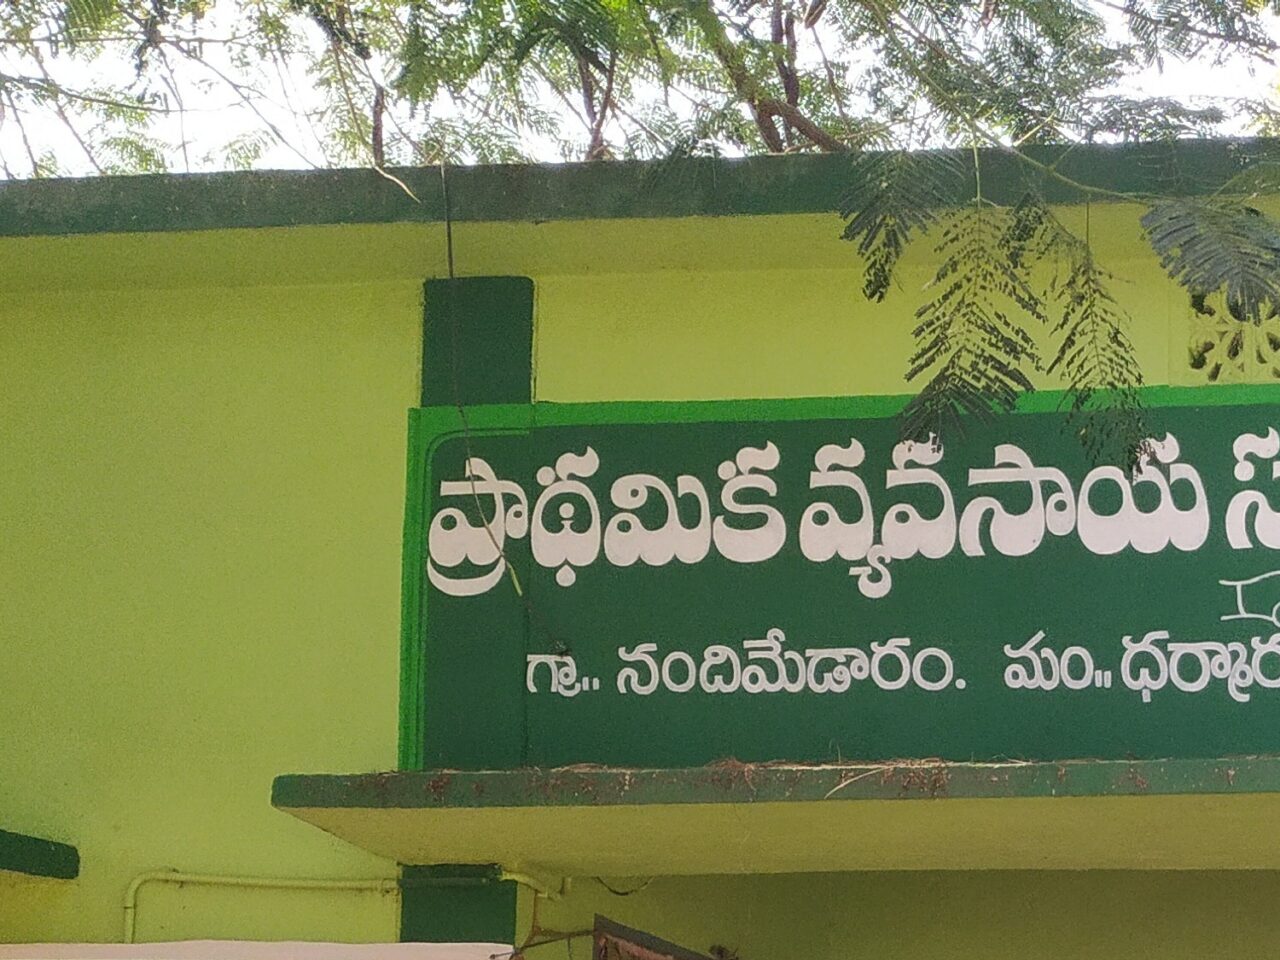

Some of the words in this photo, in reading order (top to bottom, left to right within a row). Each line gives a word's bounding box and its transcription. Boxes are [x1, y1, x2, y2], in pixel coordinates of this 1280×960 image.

[427, 441, 787, 597] ప్రాథమిక
[799, 431, 1211, 599] వ్యవసాయ
[616, 627, 966, 695] నందిమేడారం.
